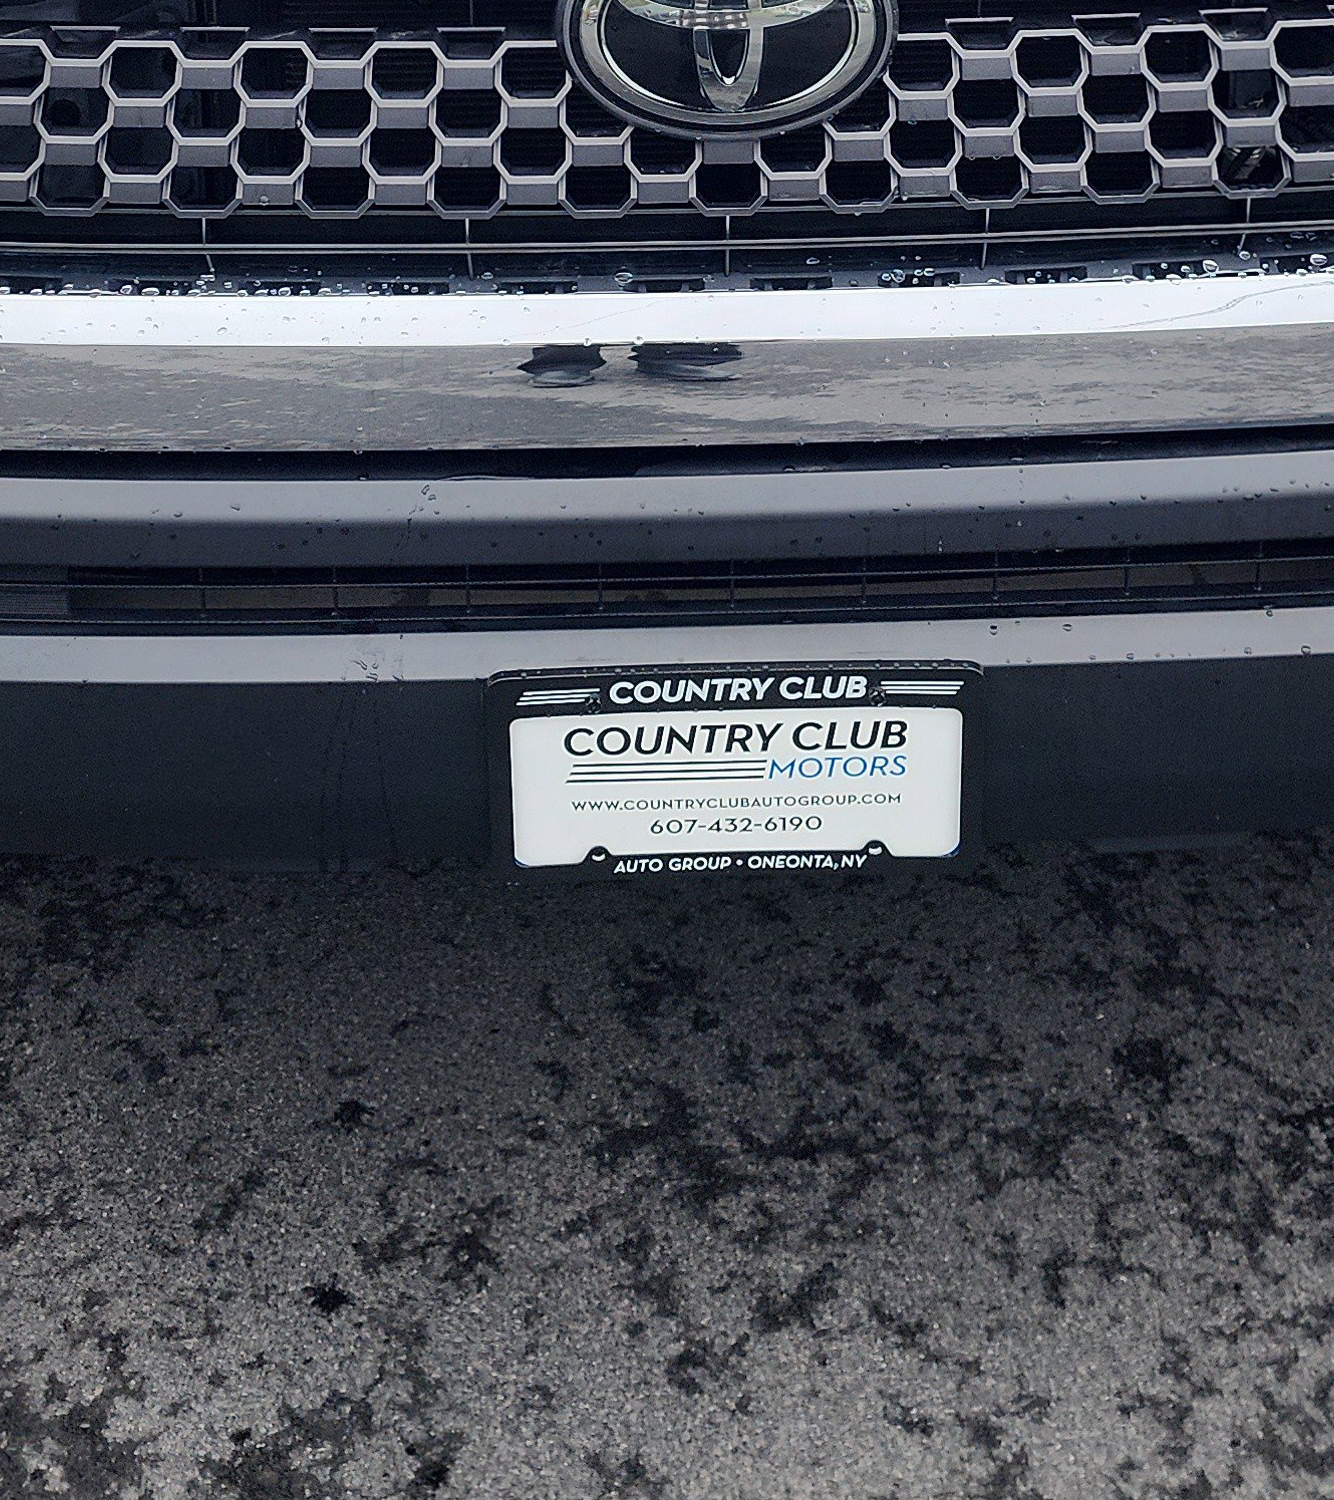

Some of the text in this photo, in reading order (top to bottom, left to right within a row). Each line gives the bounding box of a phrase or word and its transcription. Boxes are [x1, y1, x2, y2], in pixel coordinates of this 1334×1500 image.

[609, 675, 867, 705] COUNTRY CLUB
[564, 720, 908, 756] COUNTRY CLUB
[768, 755, 907, 780] MOTORS
[571, 793, 901, 812] WWW.COUNTRYCLUBAUTOGROUP.COM
[650, 815, 823, 835] 607-432-6190
[613, 859, 664, 874] AUTO
[668, 857, 732, 873] GROUP
